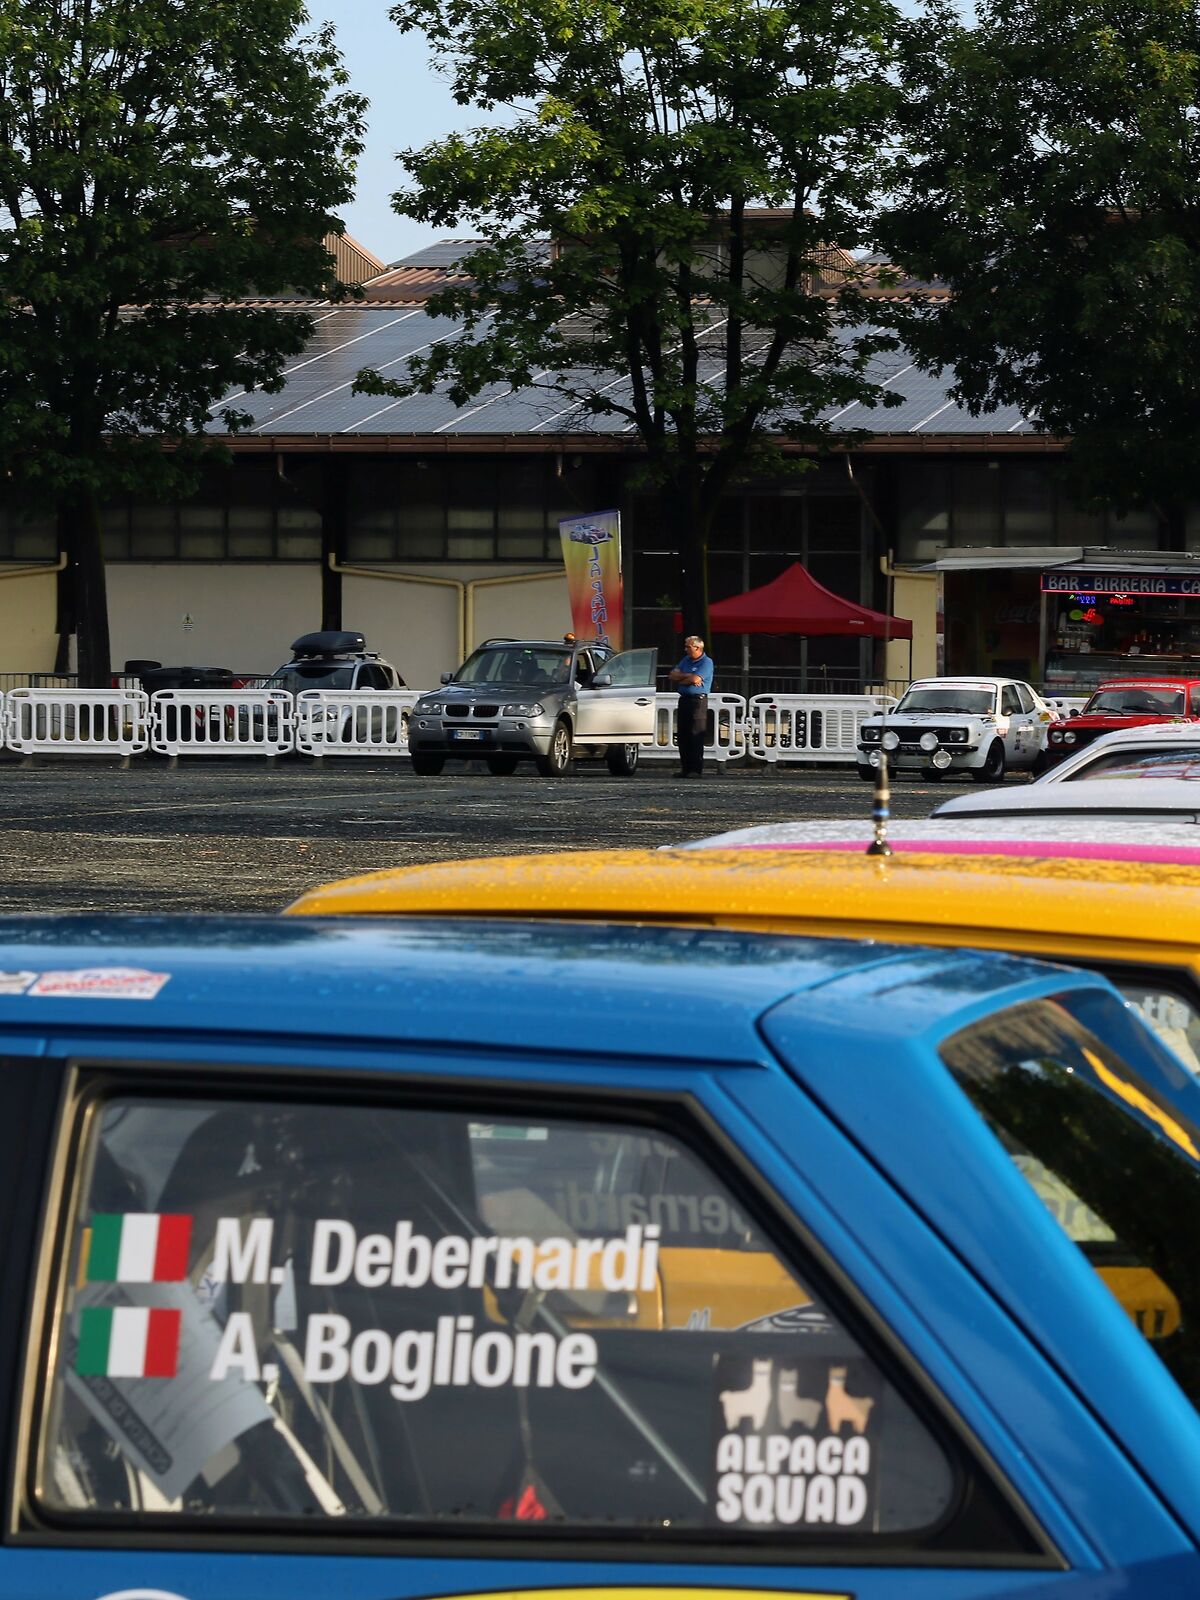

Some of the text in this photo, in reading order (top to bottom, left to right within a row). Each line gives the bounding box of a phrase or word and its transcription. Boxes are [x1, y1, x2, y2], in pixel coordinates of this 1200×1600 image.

[1048, 575, 1080, 591] BAR
[1093, 576, 1167, 593] BIRRERIA
[213, 1217, 660, 1291] M. Debernardi
[209, 1312, 598, 1401] A. Boglione
[716, 1433, 870, 1475] ALPACA
[716, 1473, 868, 1525] SQUAD
